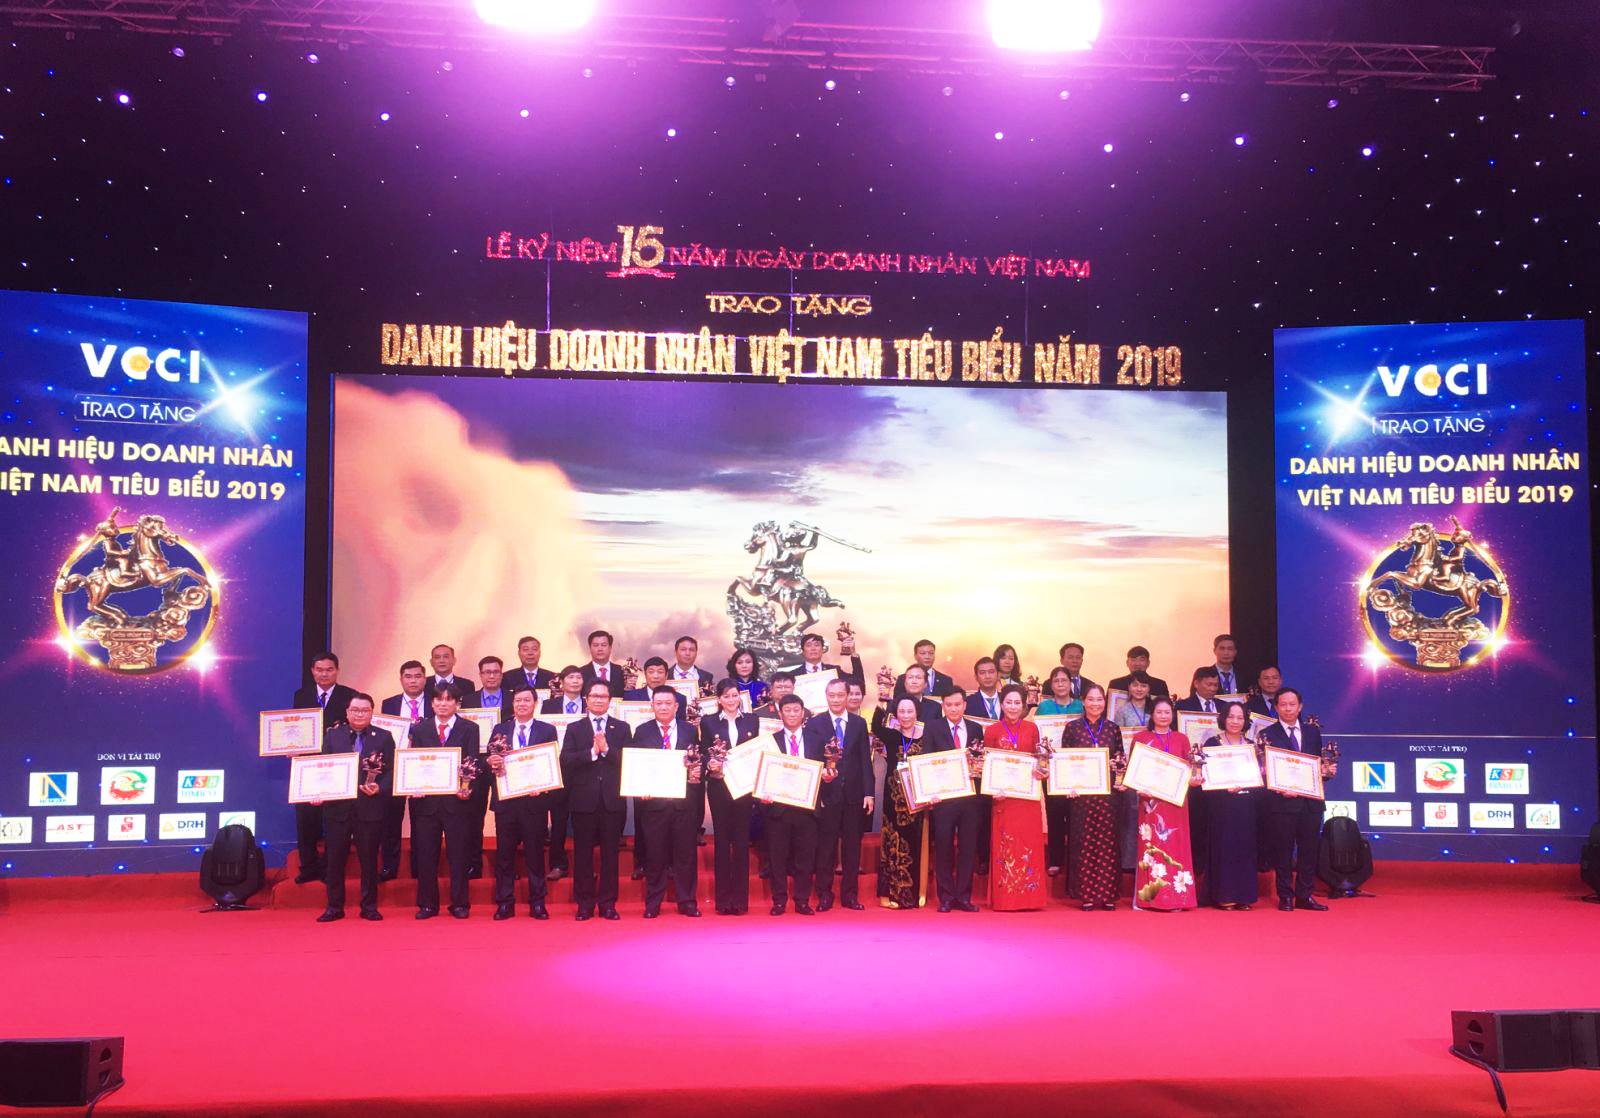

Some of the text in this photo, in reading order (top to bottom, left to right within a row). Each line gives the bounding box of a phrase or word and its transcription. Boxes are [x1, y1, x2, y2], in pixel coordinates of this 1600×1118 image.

[486, 231, 511, 259] LỄ
[556, 236, 617, 264] NIỆM
[617, 225, 665, 268] 15
[669, 243, 726, 267] NĂM
[812, 252, 900, 272] DOANH
[908, 251, 977, 275] NHÂN
[983, 252, 1029, 280] VIỆT
[1034, 257, 1091, 279] NAM
[706, 294, 872, 318] TRAO TẶNG
[80, 342, 201, 384] VCCI
[382, 320, 1182, 387] DANH HIỆU DOANH NHÂN VIỆT NAM TIÊU BIỂU NĂM 2019
[1377, 363, 1488, 397] VCCI
[81, 401, 197, 424] TRAO TẶNG
[1380, 416, 1486, 436] TRAO TẶNG
[58, 435, 115, 465] HIỆU
[123, 441, 215, 464] DOANH
[223, 443, 293, 468] NHÂN
[1290, 448, 1580, 478] DANH HIỆU DOANH NHÂN
[42, 473, 102, 494] NAM
[109, 471, 160, 496] TIÊU
[168, 469, 220, 498] BIỂU
[227, 480, 286, 500] 2019
[1297, 477, 1574, 511] VIỆT NAM TIÊU BIỂU 2019
[177, 820, 204, 829] DRH
[1487, 810, 1512, 818] DRH
